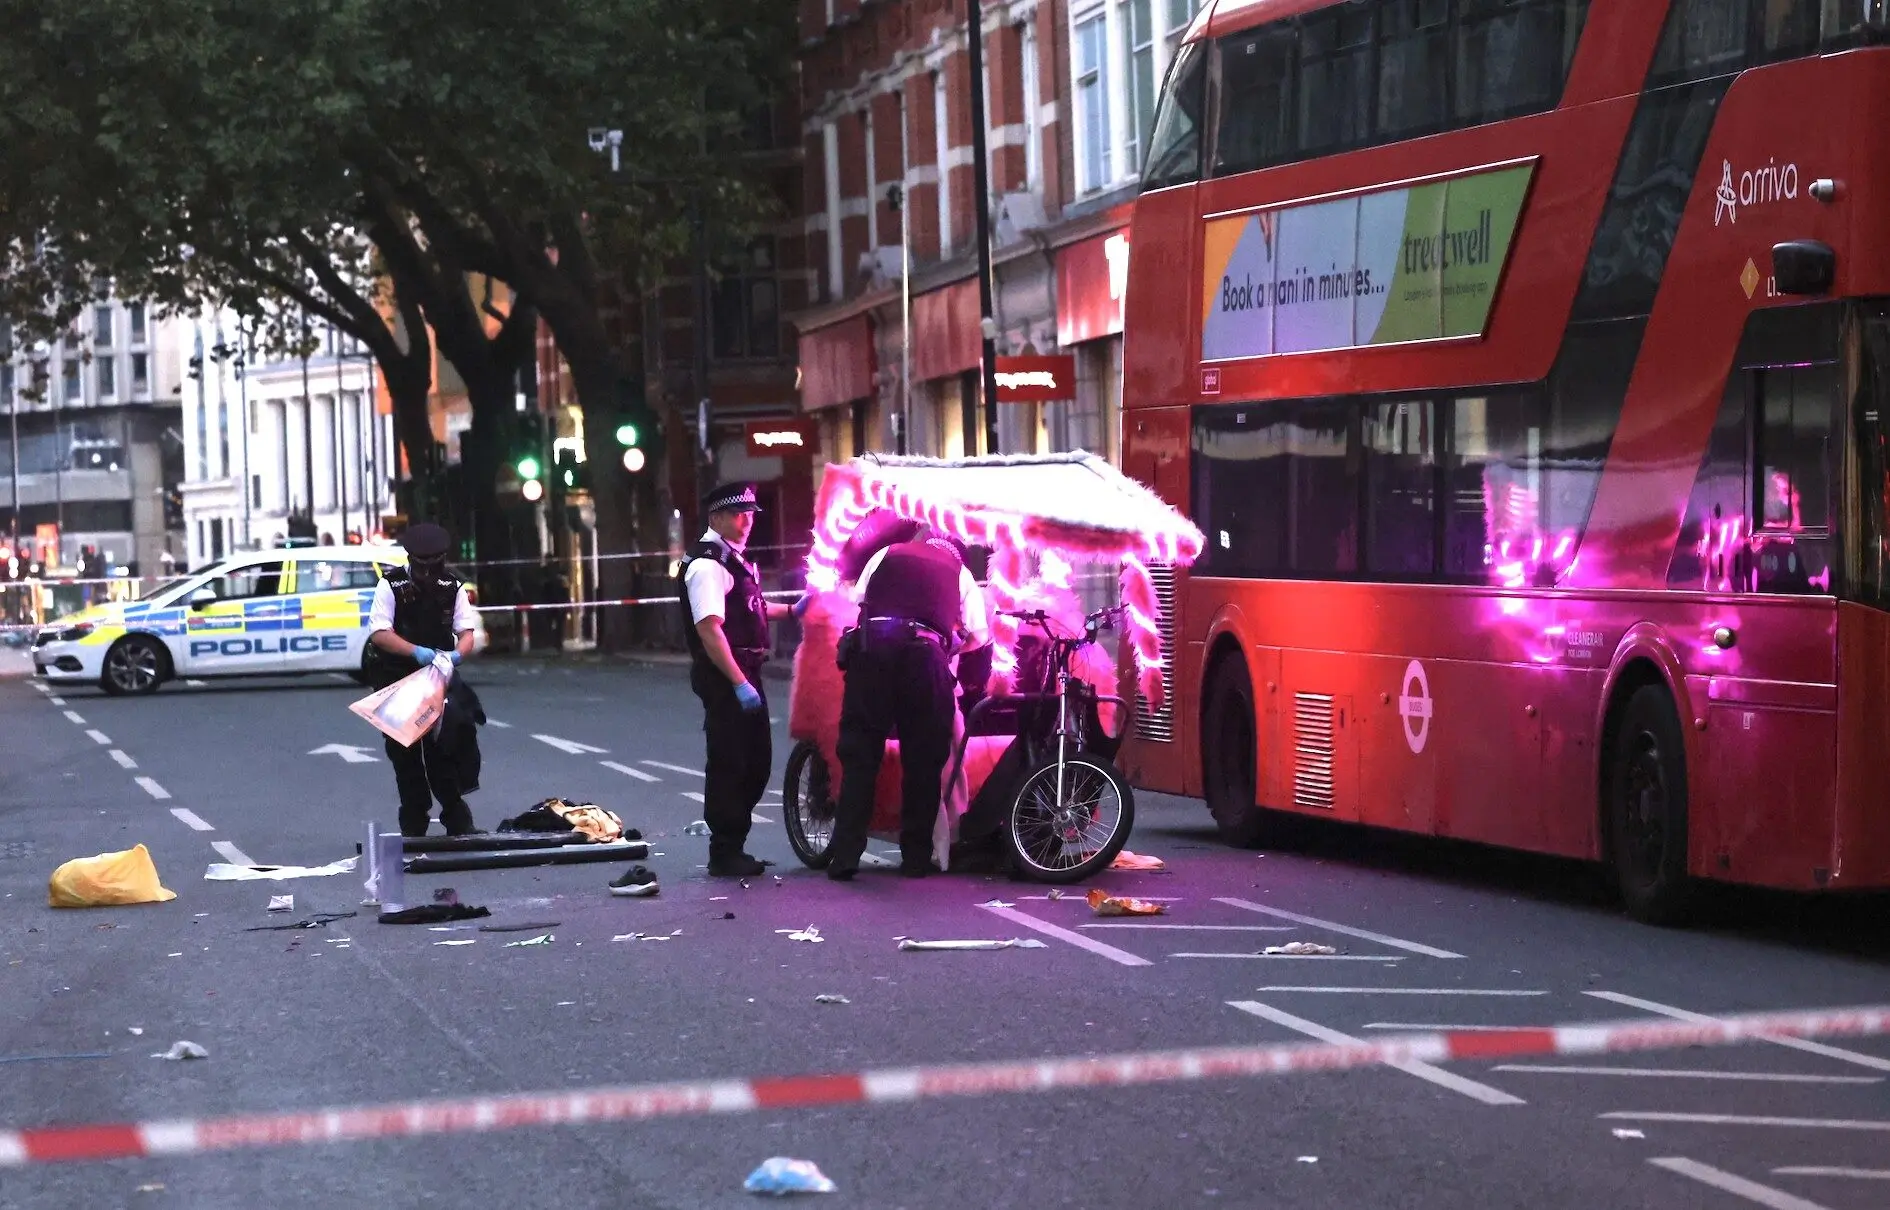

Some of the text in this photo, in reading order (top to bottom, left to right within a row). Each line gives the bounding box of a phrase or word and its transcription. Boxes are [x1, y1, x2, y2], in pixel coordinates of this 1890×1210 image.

[1740, 157, 1798, 206] arriva
[1222, 274, 1253, 312] Book
[1256, 283, 1264, 308] a
[1303, 267, 1314, 302] in
[190, 635, 348, 658] POLICE
